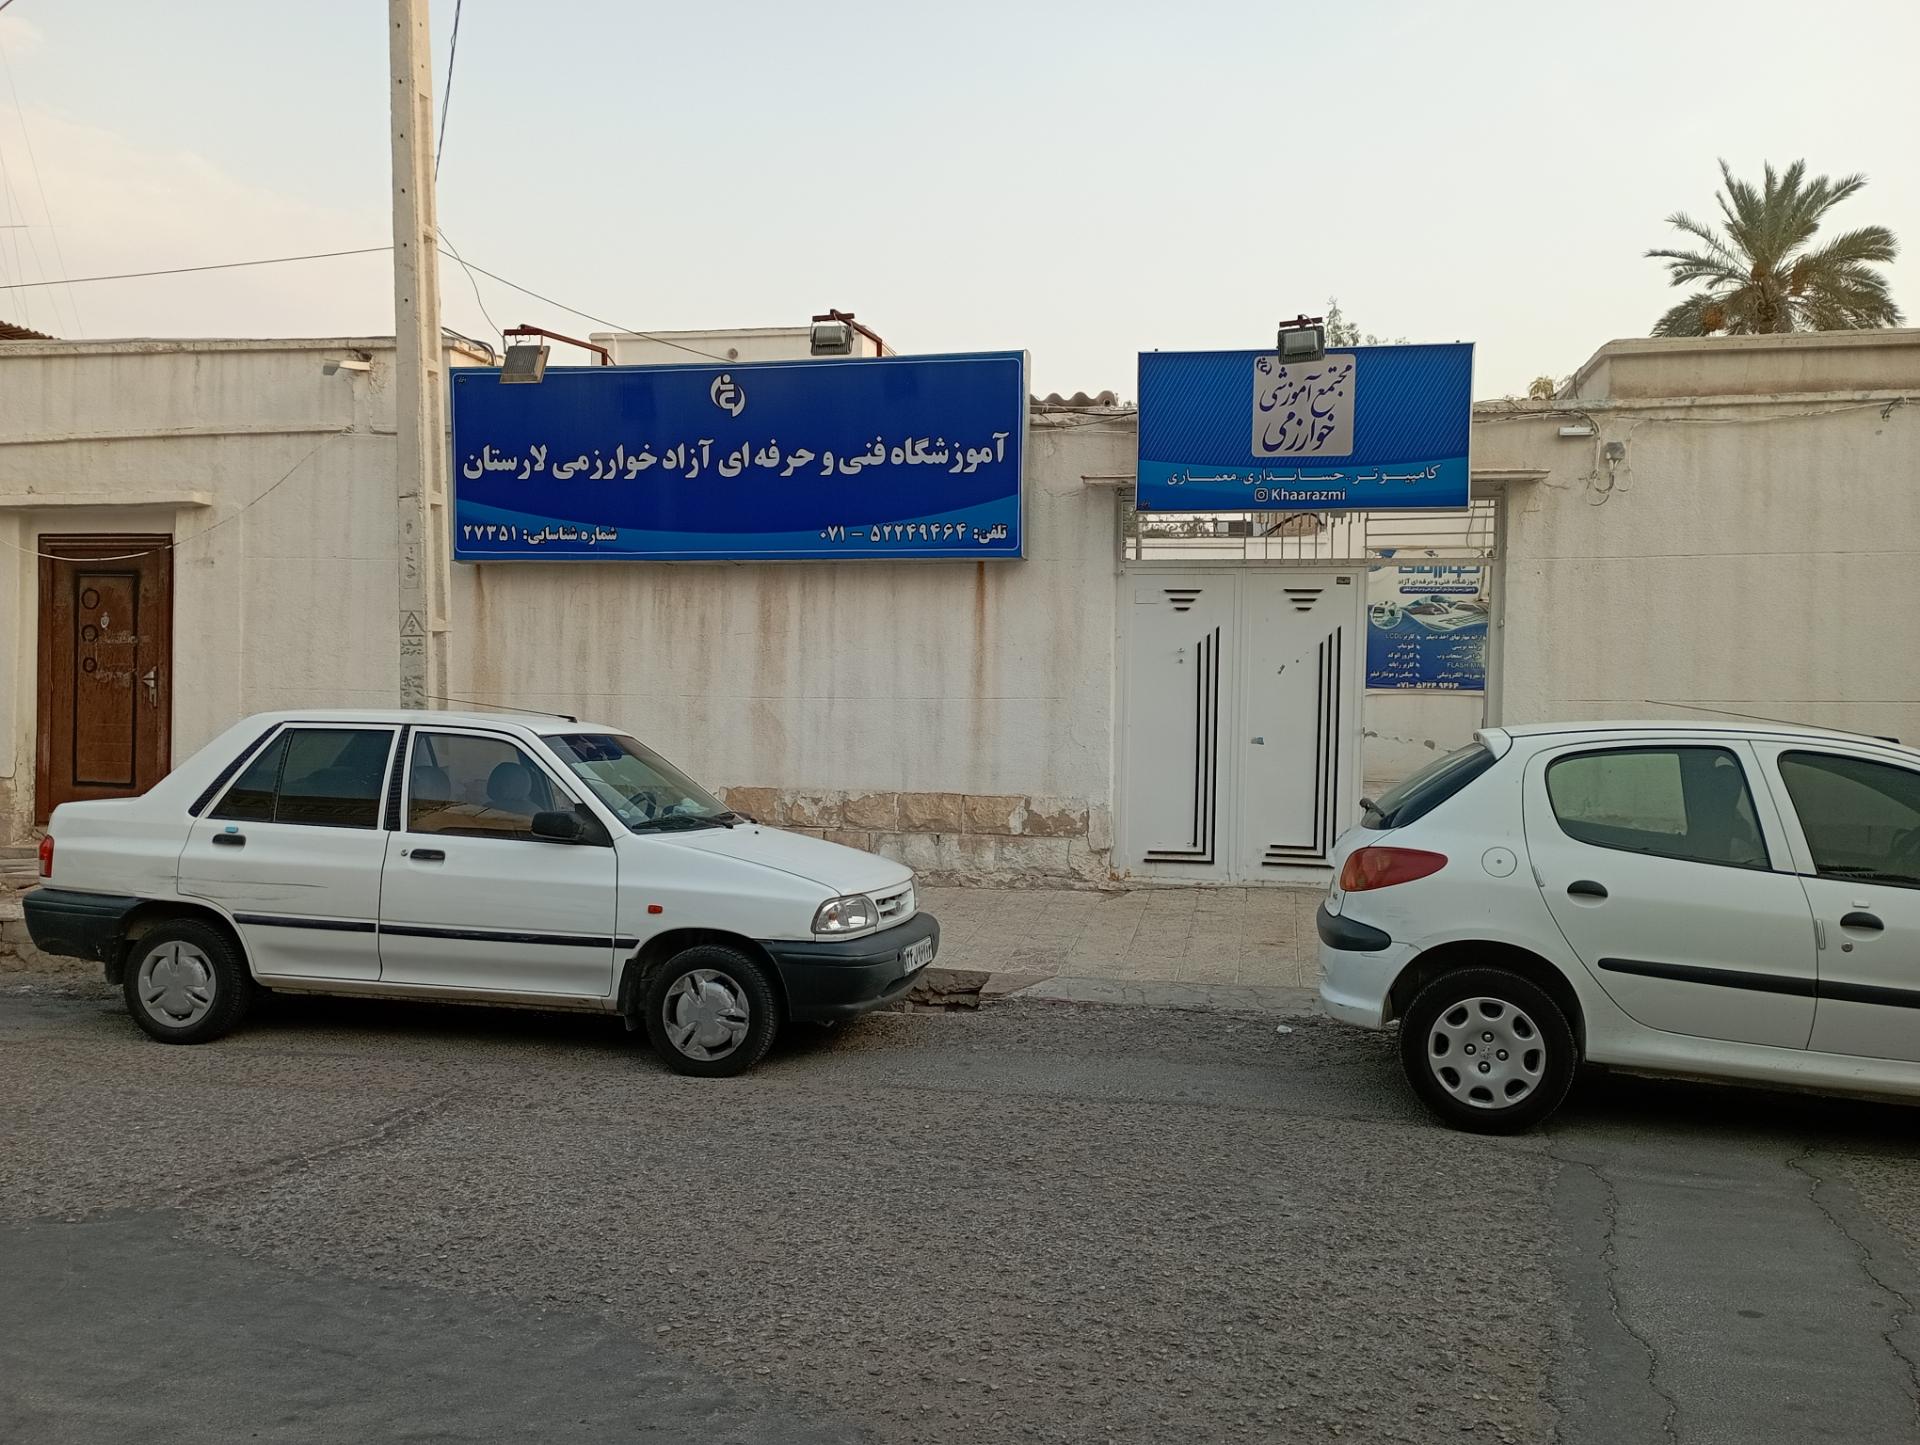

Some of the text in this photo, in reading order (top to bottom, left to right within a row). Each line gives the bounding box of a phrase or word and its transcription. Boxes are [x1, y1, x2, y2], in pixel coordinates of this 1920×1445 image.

[1259, 364, 1353, 418] مجتمع آموزشی
[1262, 411, 1336, 452] خوارزمی
[462, 431, 1010, 480] آموزشگاه فنی و حرفه ای آزاد خوارزمی لارستان
[1167, 463, 1442, 486] کامپیوتر حسابداری معماری
[1271, 488, 1346, 501] Khaarazmi
[463, 524, 618, 545] شماره شناسایی: ۲۷۳۵۱
[819, 525, 846, 542] ۰۷۱
[870, 522, 967, 542] ۵۲۲۴۹۴۶۴
[972, 523, 1008, 544] تلفن:
